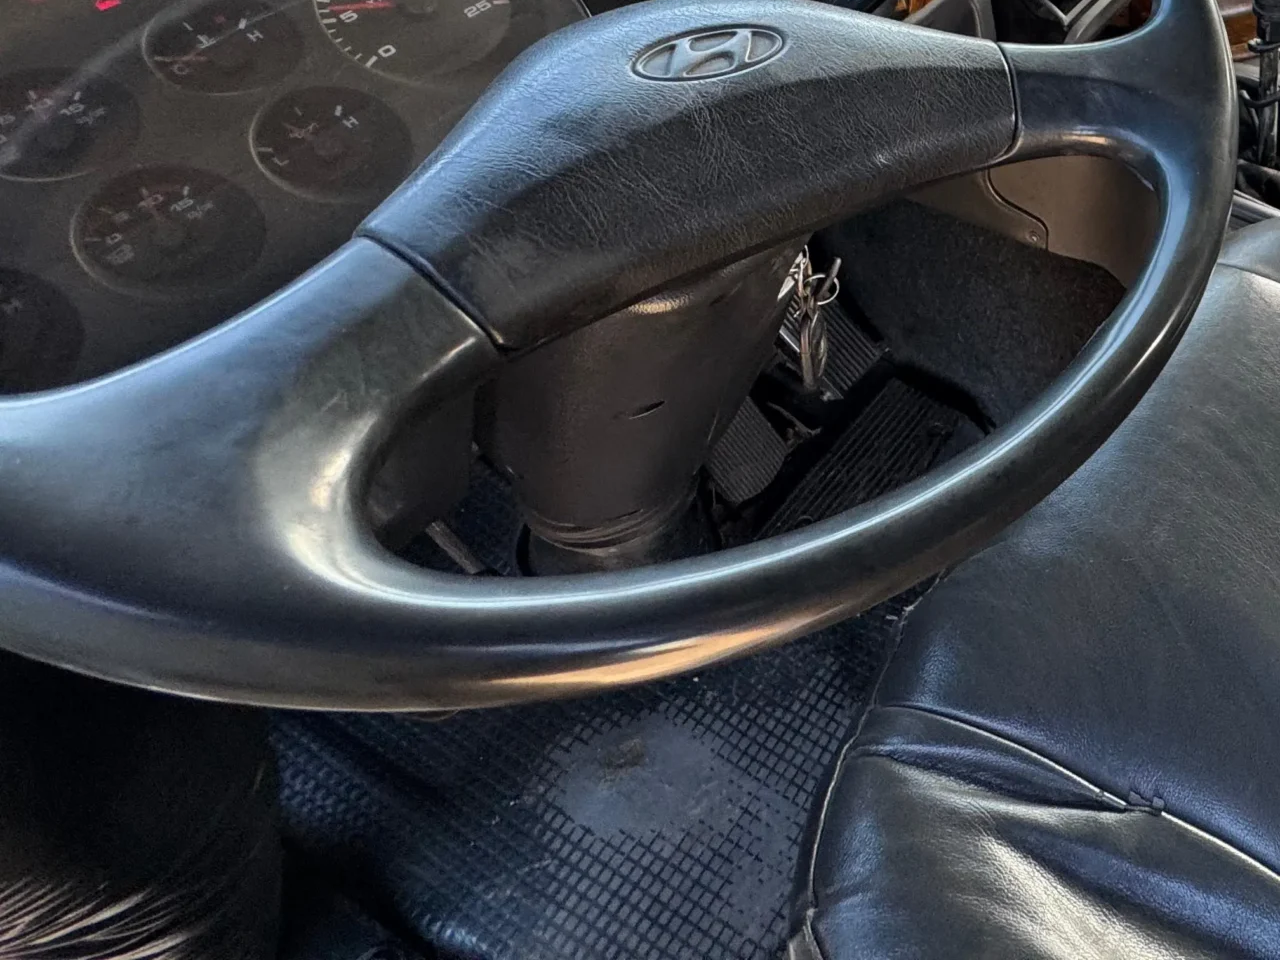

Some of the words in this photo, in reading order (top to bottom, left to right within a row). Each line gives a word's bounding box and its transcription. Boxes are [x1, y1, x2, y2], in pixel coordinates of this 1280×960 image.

[463, 0, 493, 19] 25
[339, 10, 359, 23] 5
[246, 30, 264, 42] H
[377, 44, 397, 58] 0
[342, 115, 359, 128] H
